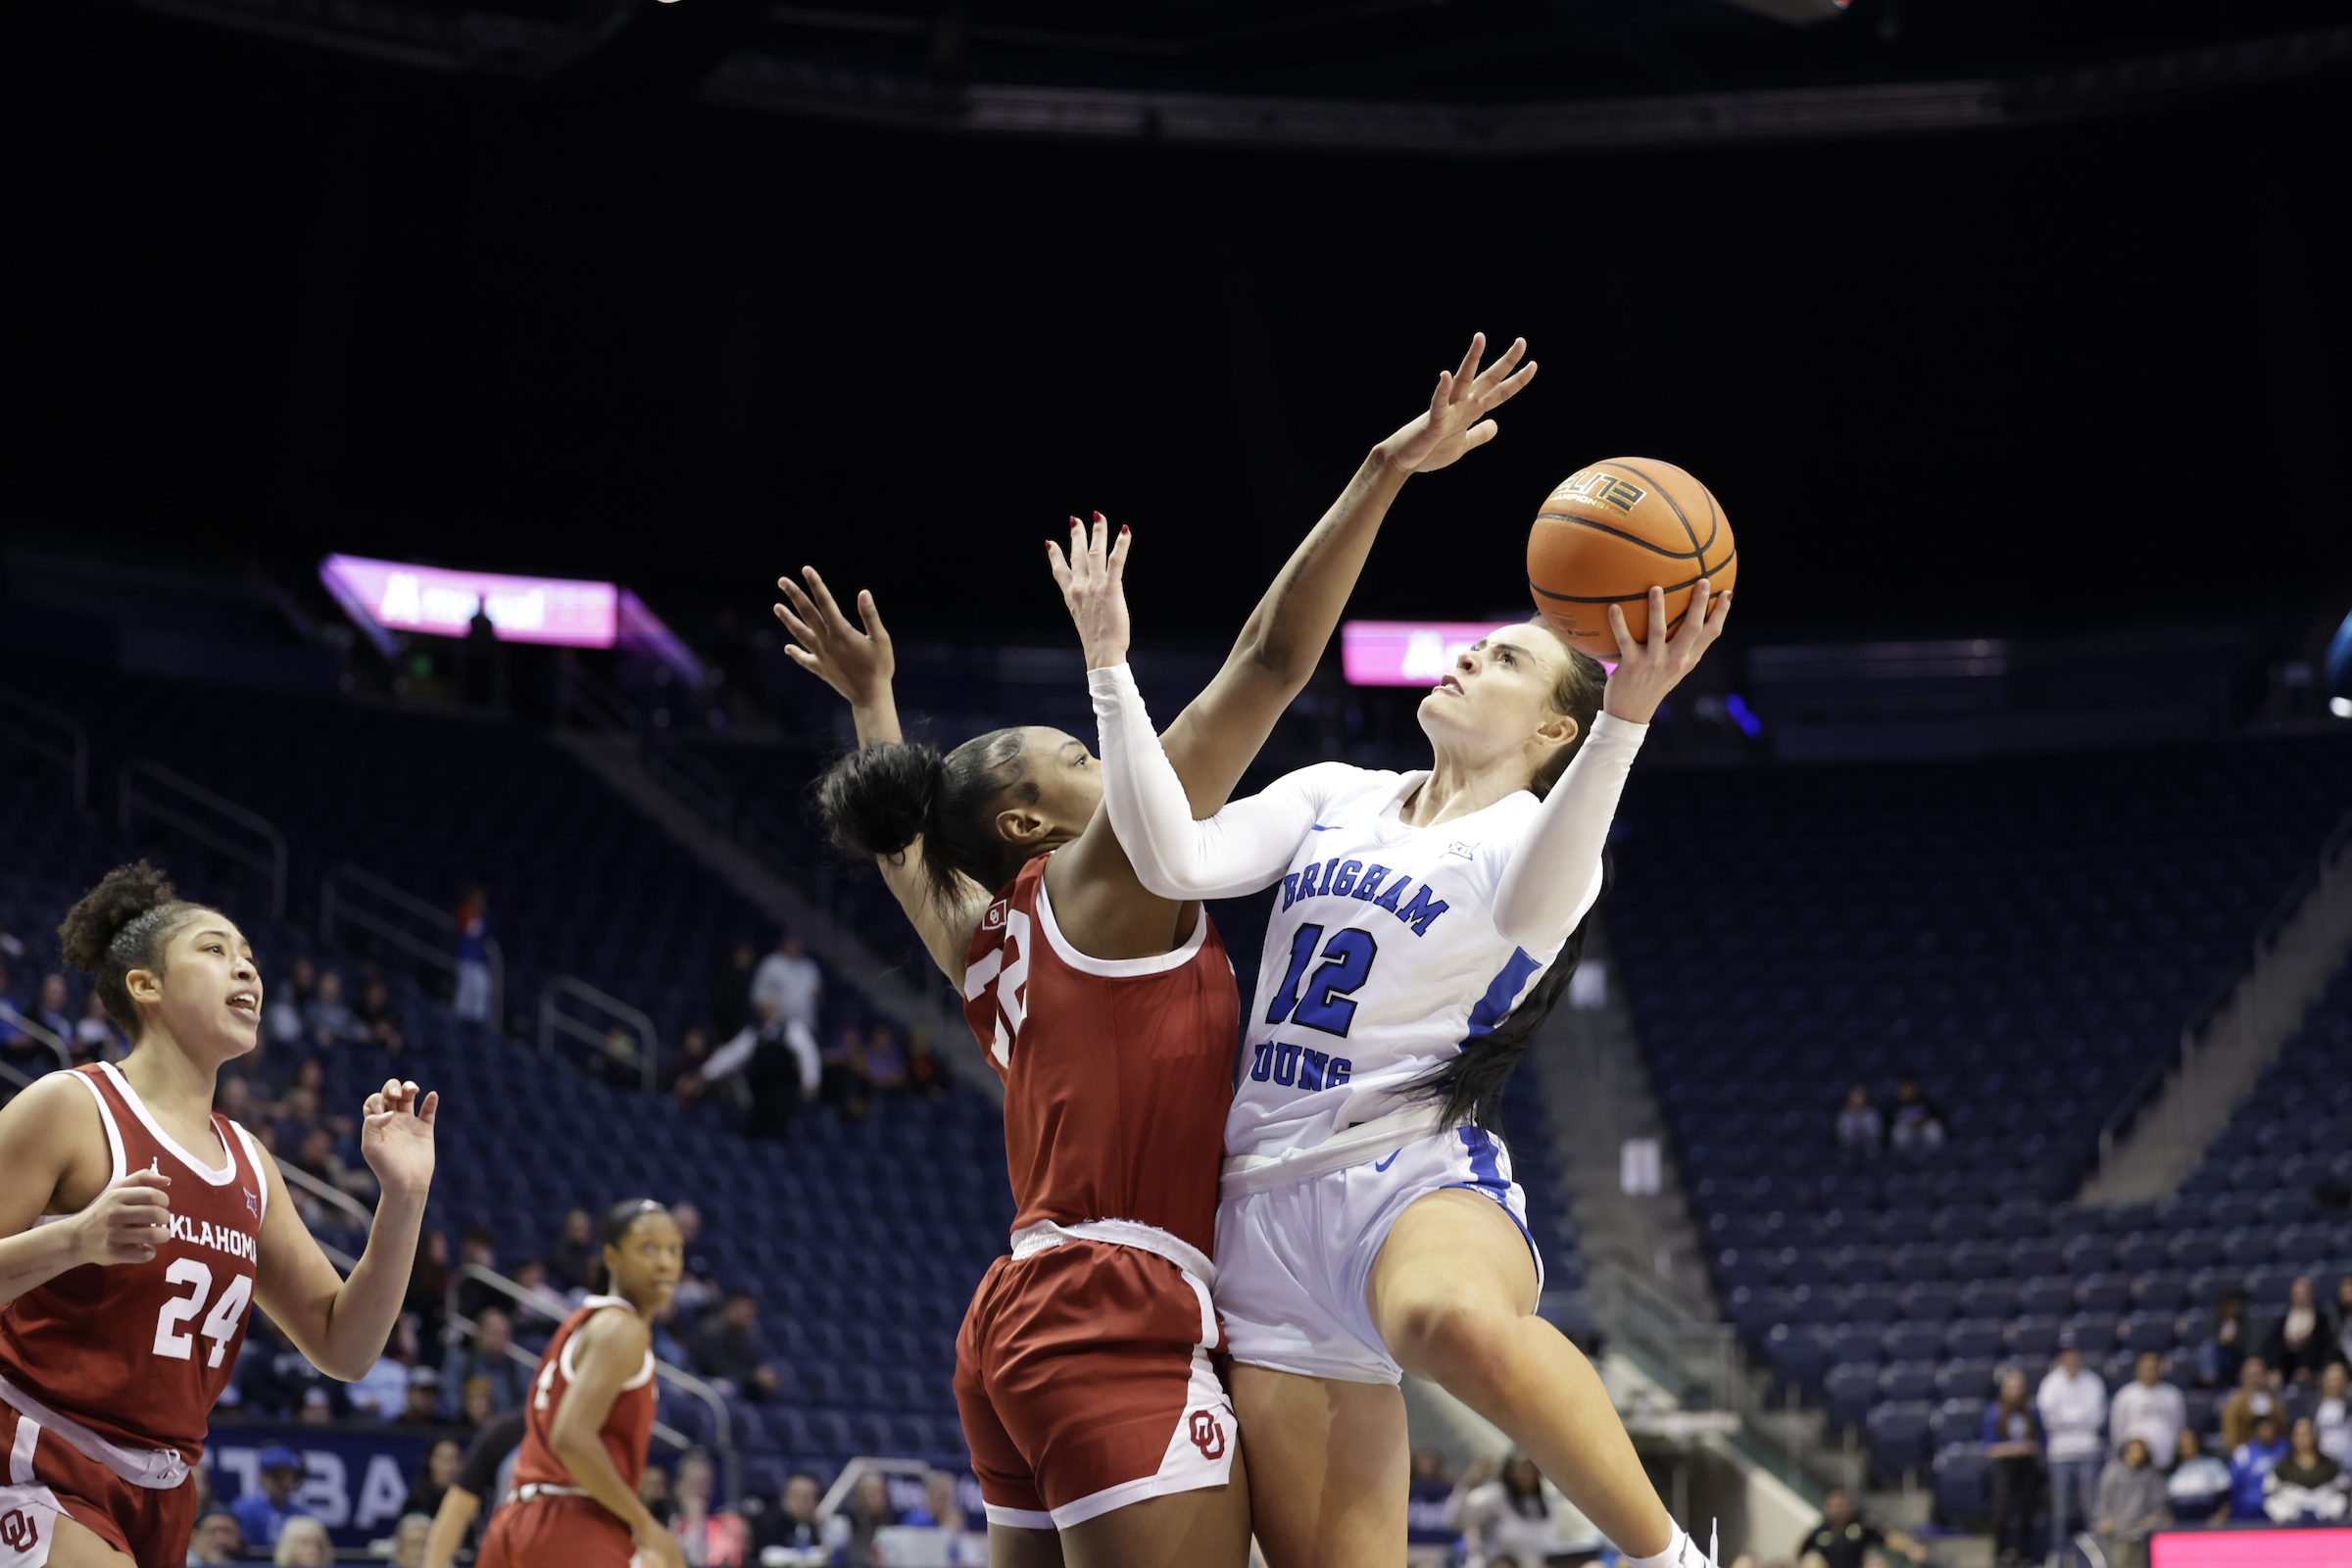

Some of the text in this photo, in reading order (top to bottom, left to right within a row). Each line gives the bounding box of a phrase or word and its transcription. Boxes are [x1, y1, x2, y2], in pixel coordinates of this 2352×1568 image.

[1337, 496, 1352, 519] will
[1282, 858, 1449, 937] BRIGHAM
[1265, 922, 1378, 1039] 12
[1250, 1041, 1352, 1092] OUNG
[152, 1256, 253, 1369] 24
[1189, 1410, 1225, 1461] OU
[0, 1509, 38, 1553] OU
